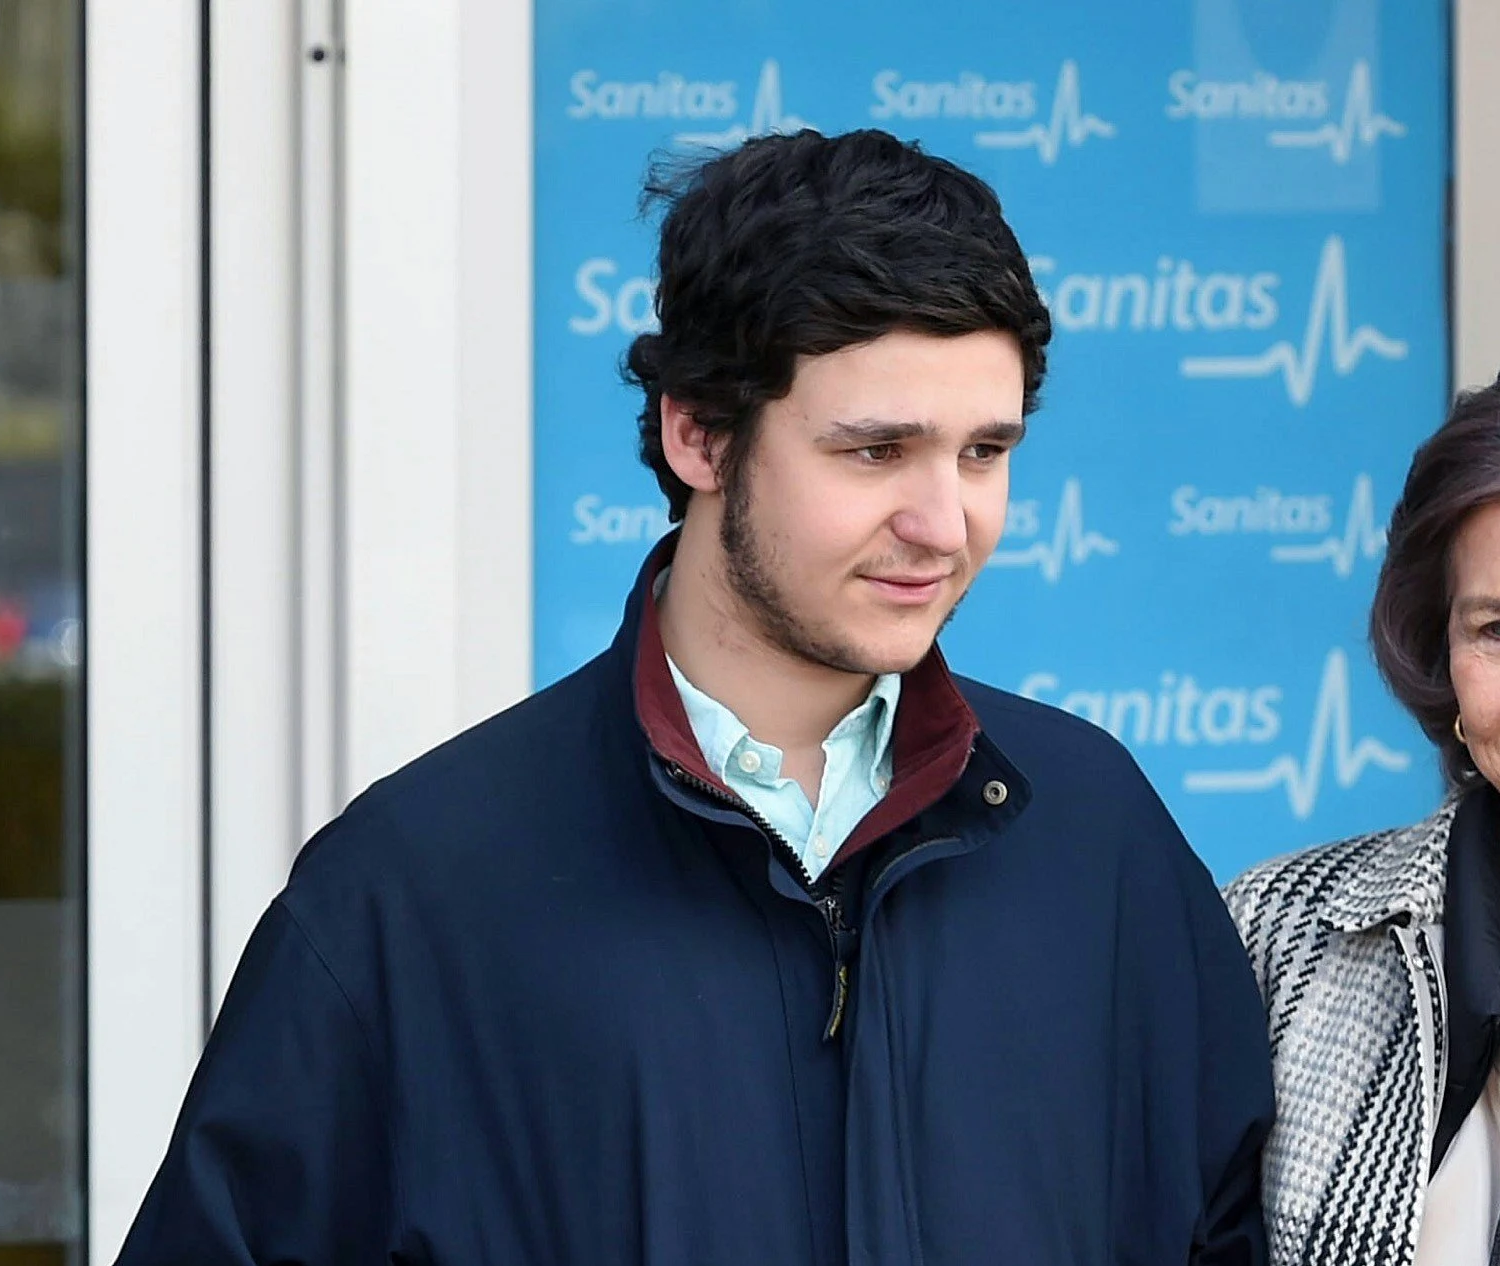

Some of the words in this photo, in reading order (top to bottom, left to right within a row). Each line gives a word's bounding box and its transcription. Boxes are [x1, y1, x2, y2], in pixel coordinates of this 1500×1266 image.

[569, 70, 738, 119] Sanitas
[870, 70, 1037, 119] Sanitas
[1166, 69, 1329, 119] Sanitas
[1169, 486, 1332, 535] Sanitas
